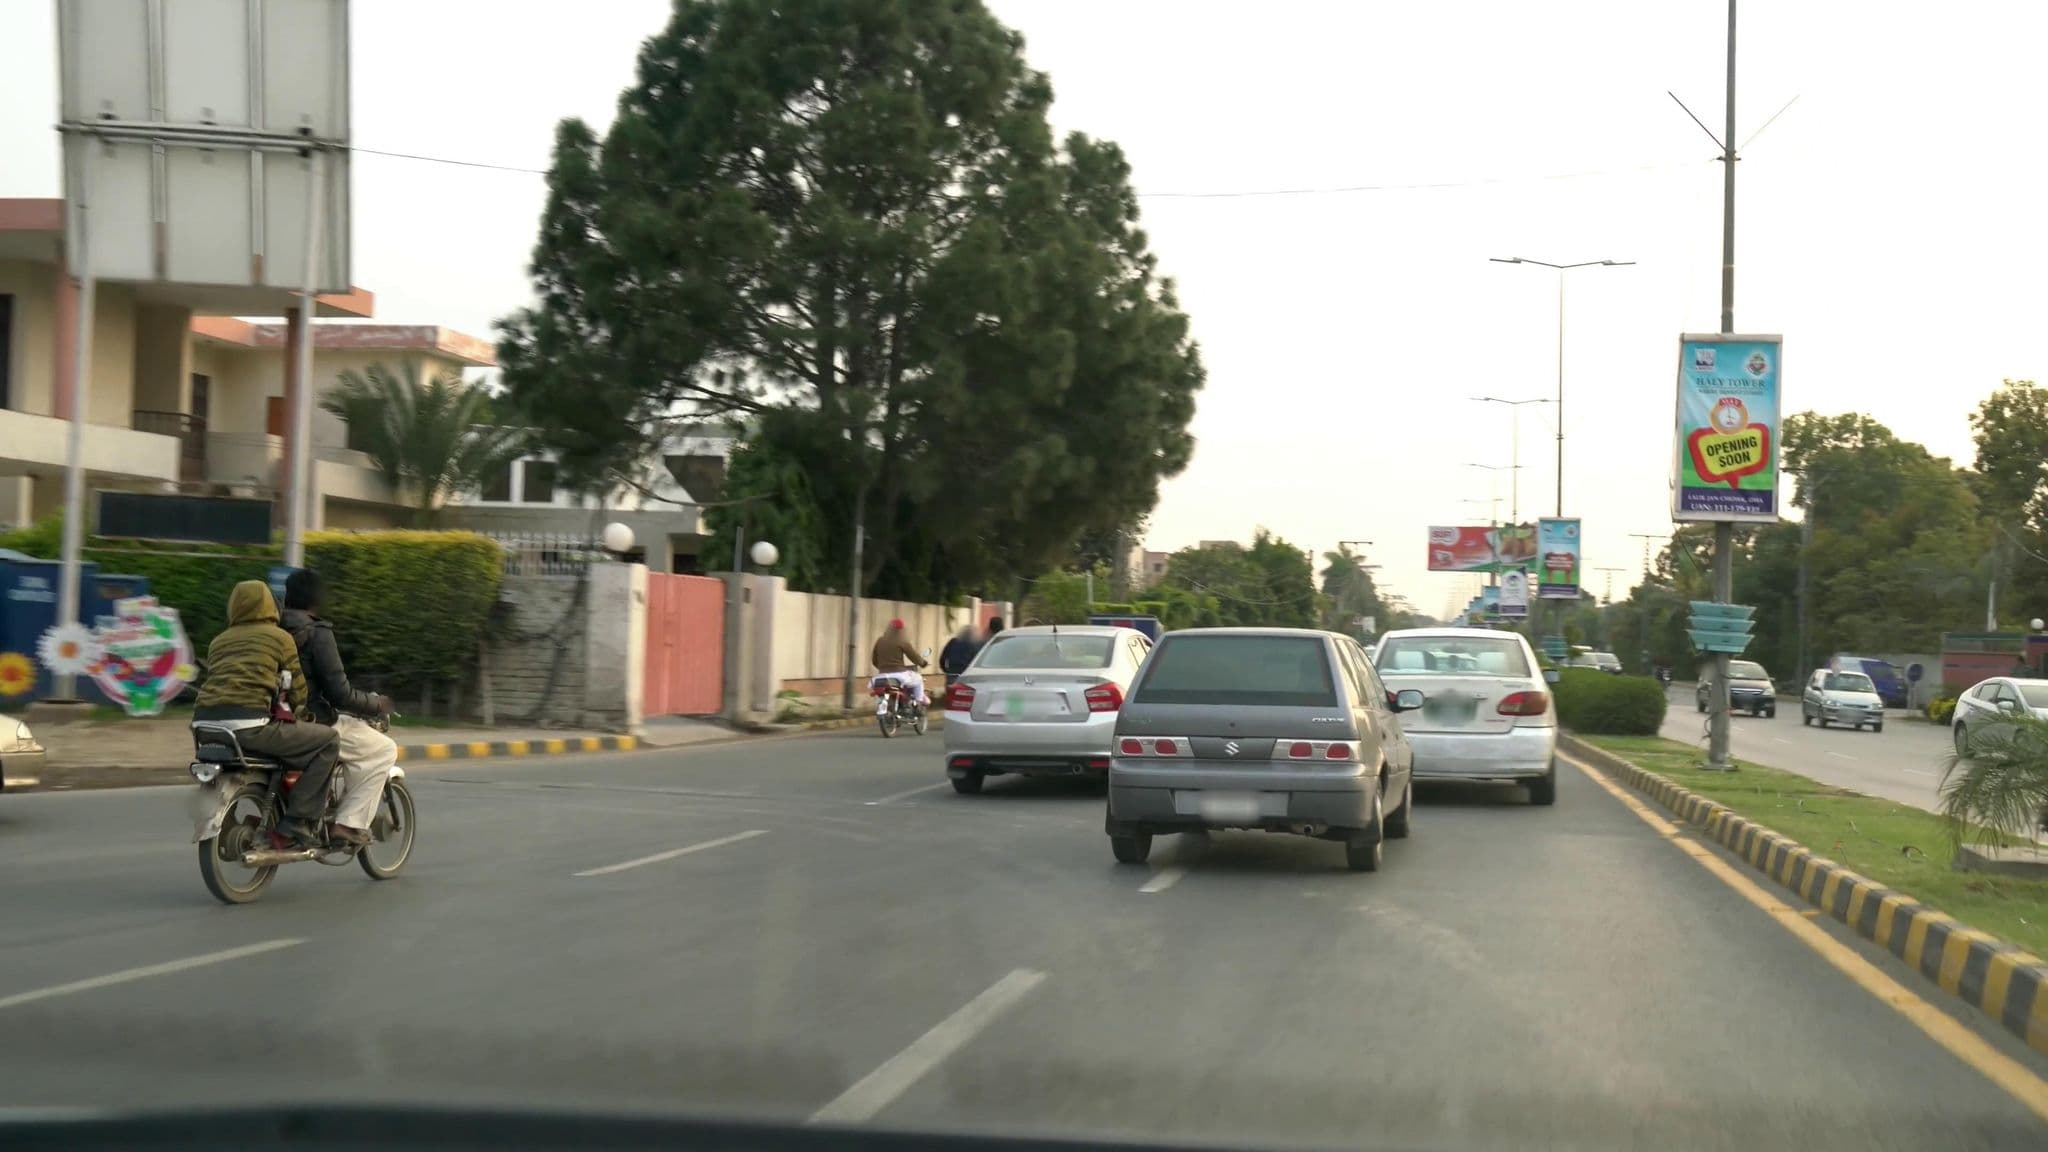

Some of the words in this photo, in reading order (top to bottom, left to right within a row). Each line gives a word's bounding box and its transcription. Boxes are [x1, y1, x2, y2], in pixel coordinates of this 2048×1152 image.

[1728, 378, 1766, 388] TOWER
[1706, 437, 1758, 456] OPENING
[1718, 451, 1751, 467] SOON
